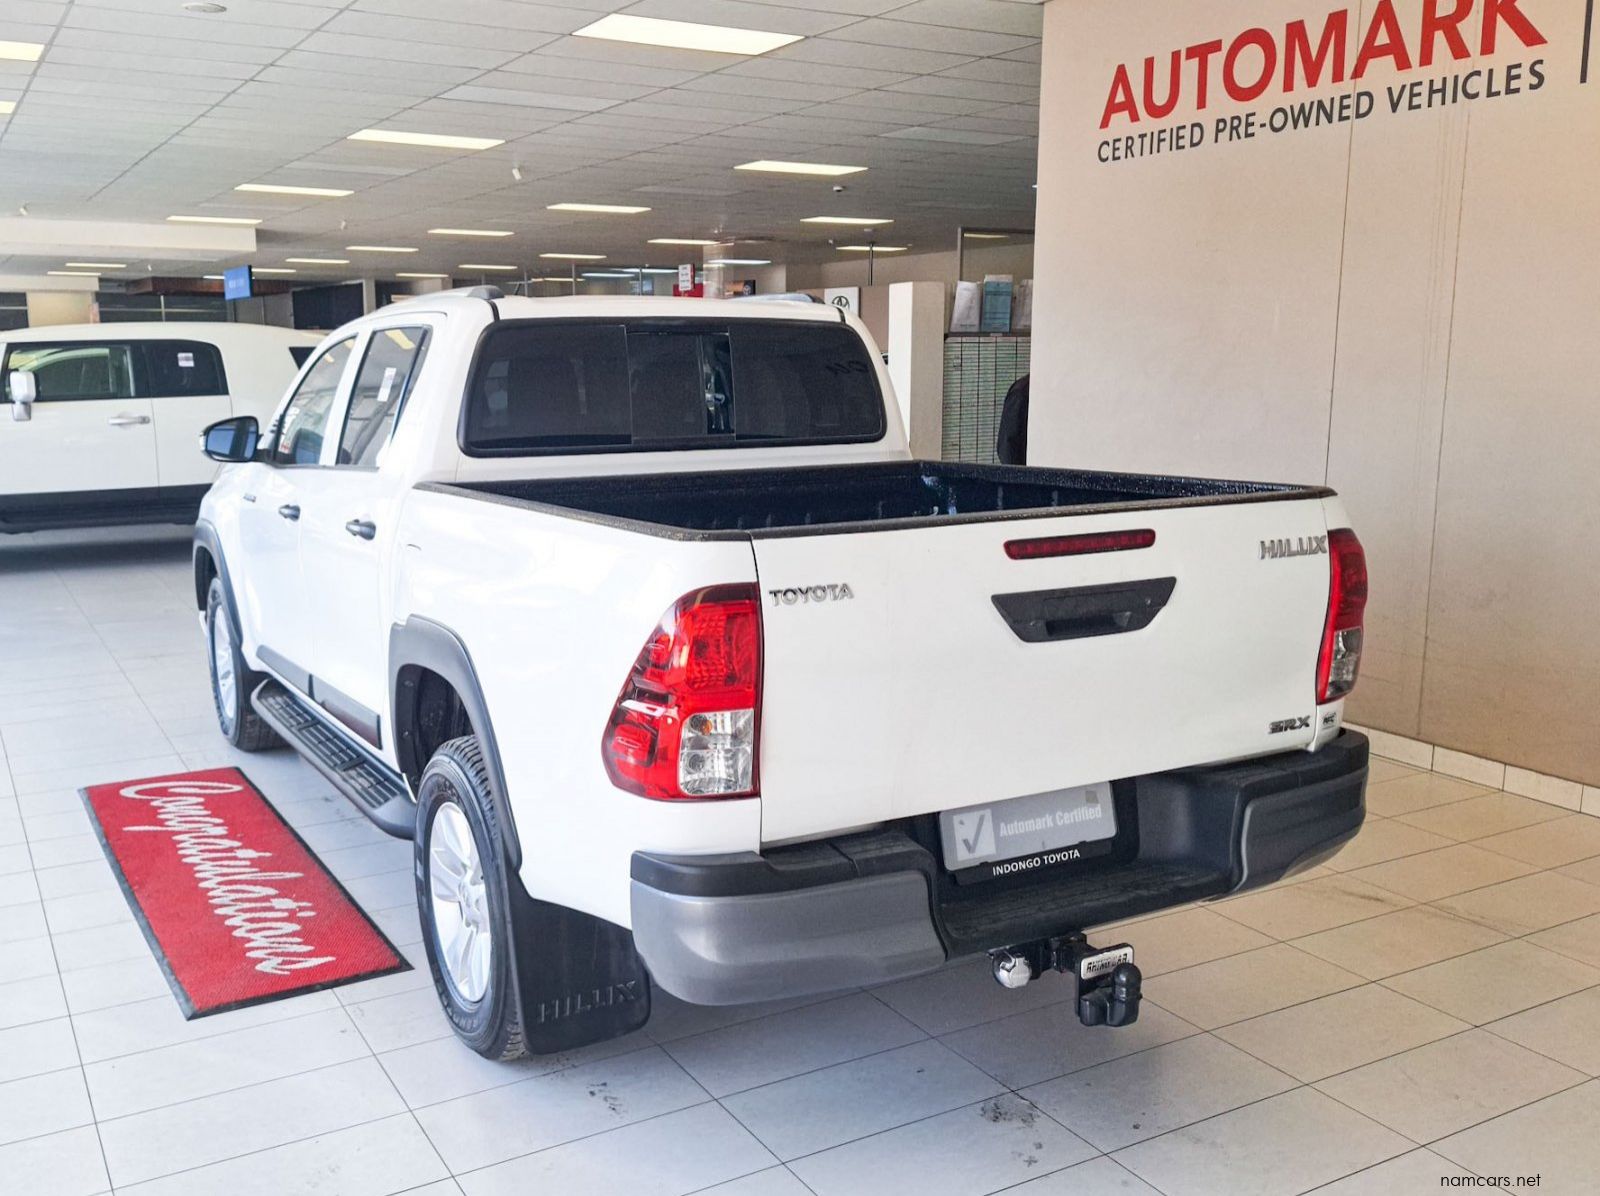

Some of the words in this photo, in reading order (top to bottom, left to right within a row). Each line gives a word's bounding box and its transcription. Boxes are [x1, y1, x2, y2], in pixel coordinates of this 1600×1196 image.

[1099, 0, 1549, 130] AUTOMARK
[1097, 122, 1205, 163] CERTIFIED
[1213, 90, 1375, 144] PRE-OWNED
[1386, 59, 1546, 114] VEHICLES
[1260, 535, 1327, 560] HILUX
[769, 583, 855, 607] TOYOTA
[1268, 715, 1310, 734] SRX
[1000, 813, 1054, 838] Automark
[1056, 805, 1102, 825] Certified
[119, 781, 336, 975] Congratulations
[992, 857, 1041, 876] INDONGO
[1043, 848, 1081, 866] TOYOTA
[538, 980, 636, 1024] HILUX
